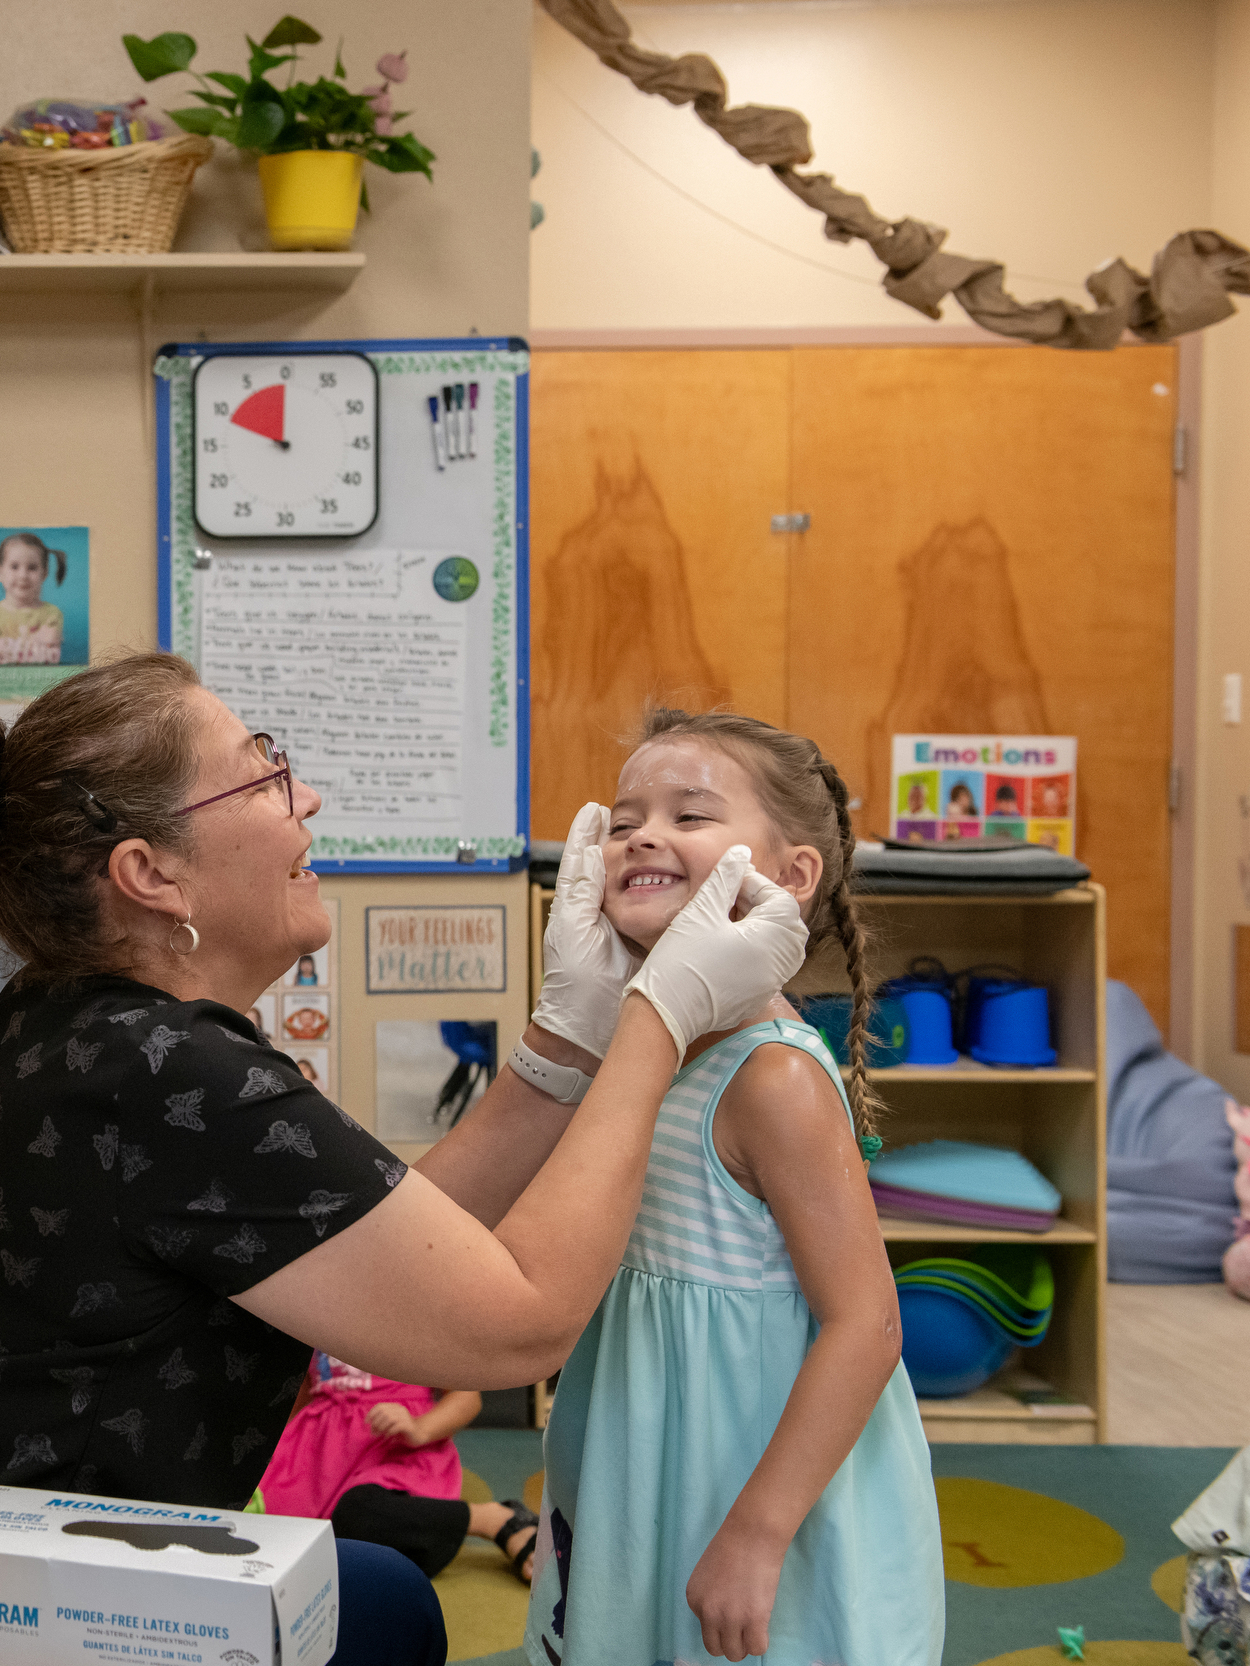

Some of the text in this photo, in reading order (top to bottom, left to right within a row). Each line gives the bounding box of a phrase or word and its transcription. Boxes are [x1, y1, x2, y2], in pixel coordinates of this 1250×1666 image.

[242, 374, 253, 389] 5
[280, 365, 291, 381] 0
[319, 372, 338, 388] 55
[213, 401, 229, 417] 10
[346, 399, 364, 416] 50
[203, 437, 218, 453] 15
[352, 435, 371, 452] 45
[210, 472, 228, 489] 20
[342, 470, 362, 487] 40
[233, 502, 252, 518] 25
[320, 499, 338, 515] 35
[276, 512, 294, 528] 30
[914, 738, 1056, 765] Emotions
[379, 916, 496, 947] YOUR FEELINGS
[377, 949, 488, 982] Matter
[45, 1498, 222, 1522] MONOGRAM
[56, 1606, 230, 1640] POWDER-FREE LATEX GLOVES
[87, 1627, 198, 1648] NON-STERILE AMBIDEXTROUS
[83, 1640, 203, 1664] GUANTES DE LÁTEX SIN TALCO
